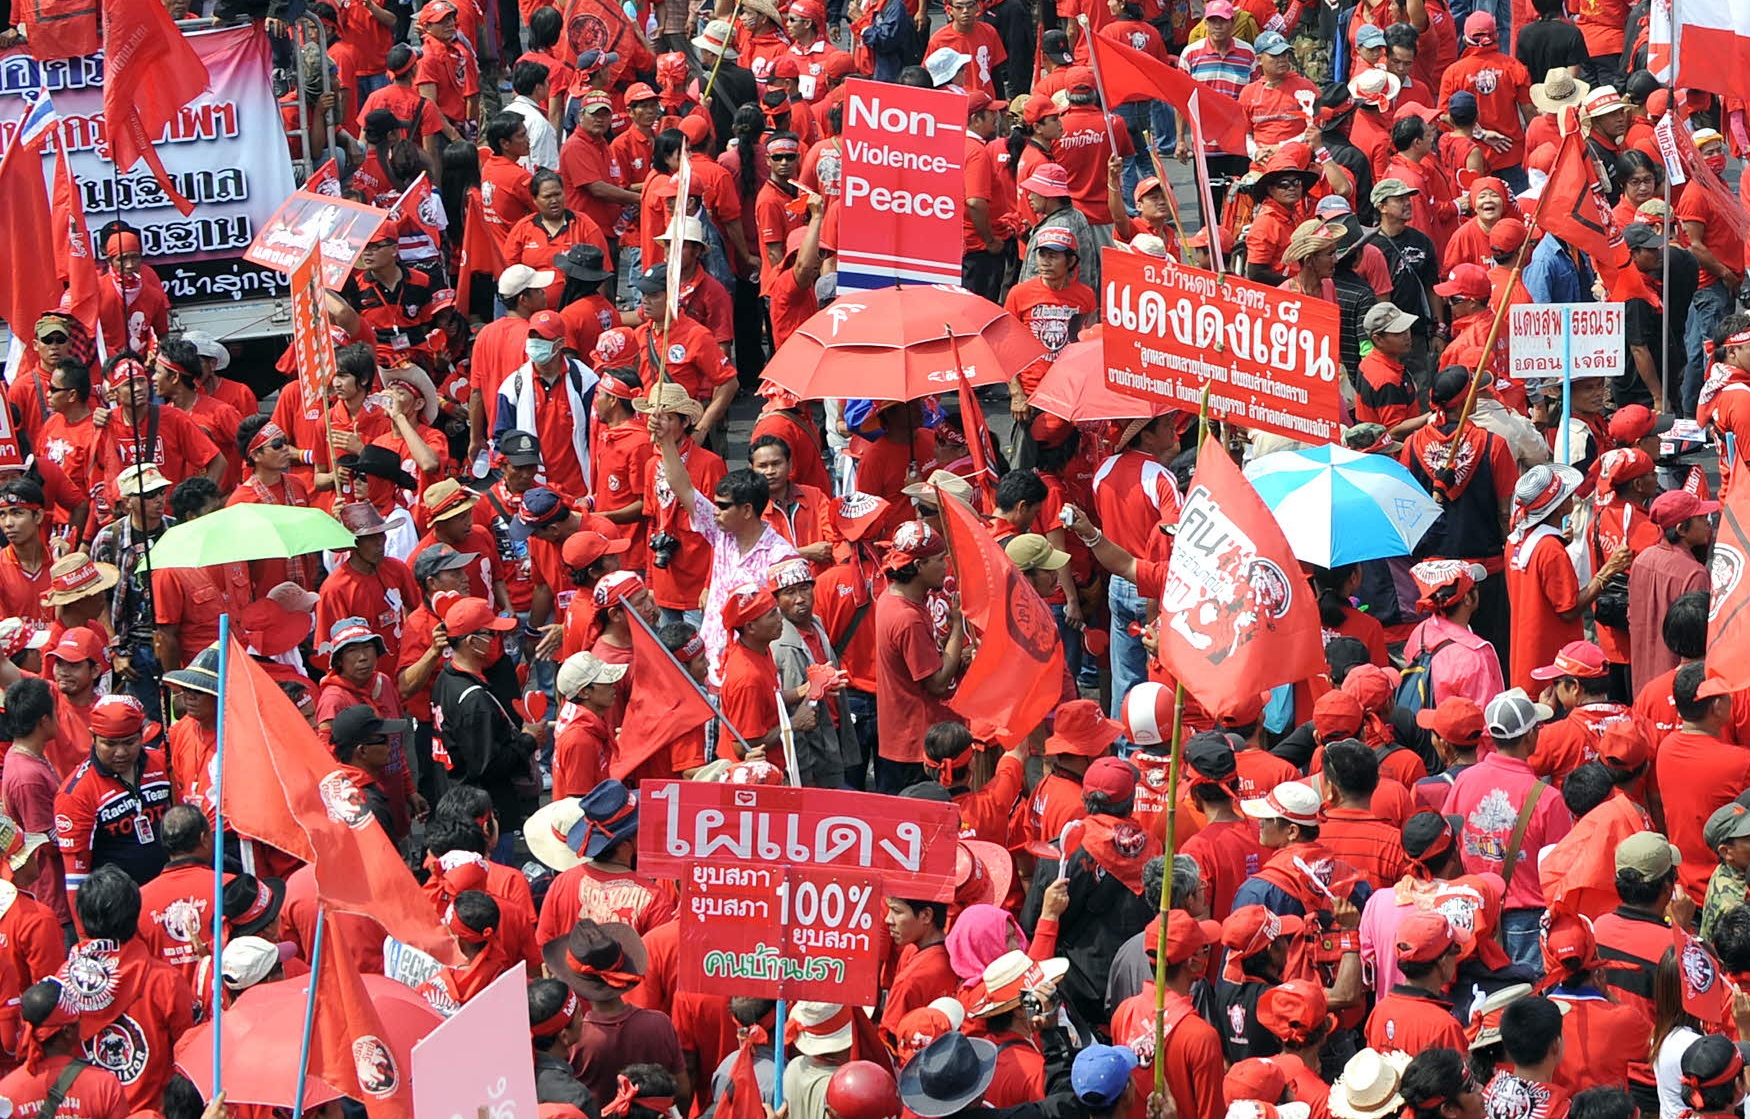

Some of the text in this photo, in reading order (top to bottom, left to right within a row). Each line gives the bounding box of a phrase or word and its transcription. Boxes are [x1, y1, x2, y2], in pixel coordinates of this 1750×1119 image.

[848, 94, 963, 138] Non-
[845, 138, 961, 174] Violence-
[845, 175, 956, 220] Peace
[1106, 280, 1337, 383] แดงดงเย็น
[693, 865, 771, 892] ยุบสภา
[690, 896, 769, 923] ยุบสภา
[775, 880, 874, 931] 100%
[792, 928, 870, 955] ยุบสภา
[703, 942, 845, 984] คนบ้านเรา
